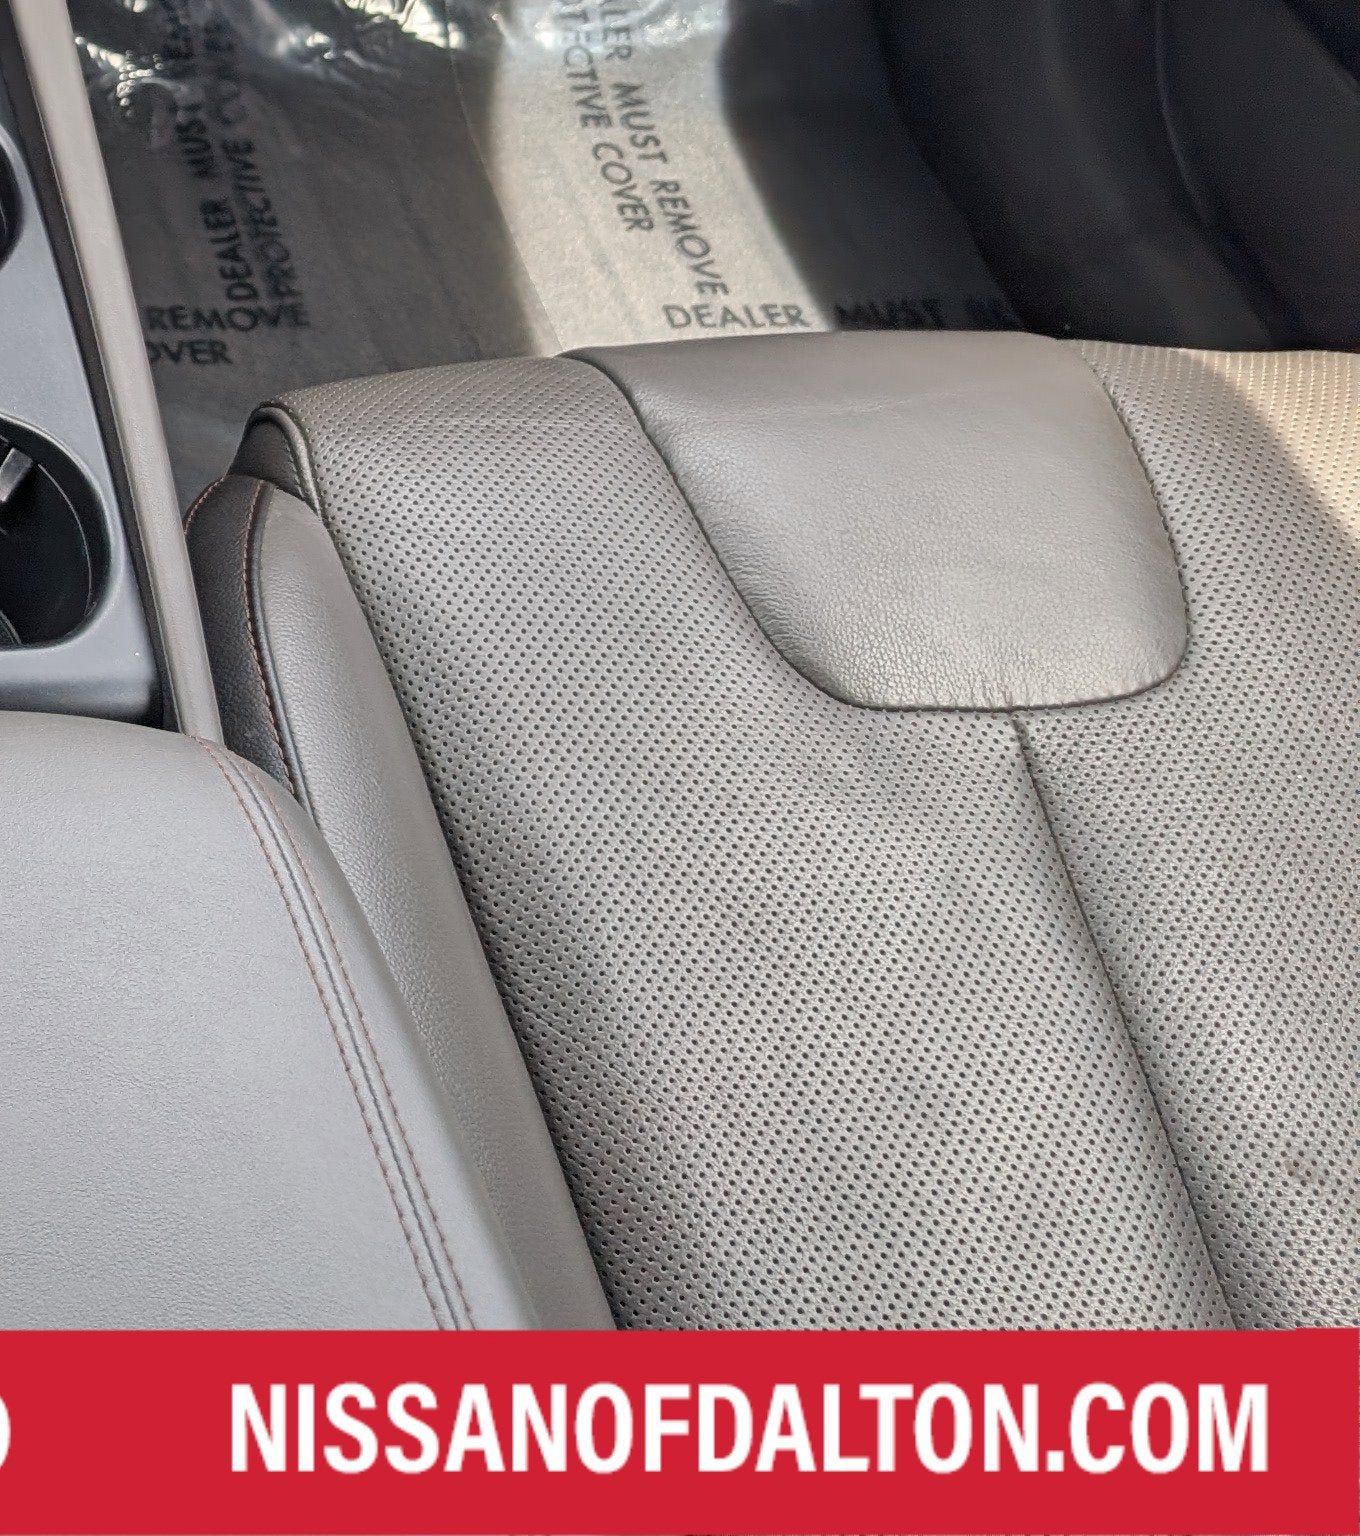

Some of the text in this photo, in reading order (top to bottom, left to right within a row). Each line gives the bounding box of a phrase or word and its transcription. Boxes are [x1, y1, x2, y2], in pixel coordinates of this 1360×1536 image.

[591, 142, 654, 233] COVER
[611, 81, 669, 165] MUST
[649, 179, 730, 297] REMOVE
[199, 197, 259, 301] DEALER
[661, 303, 810, 331] DEALER
